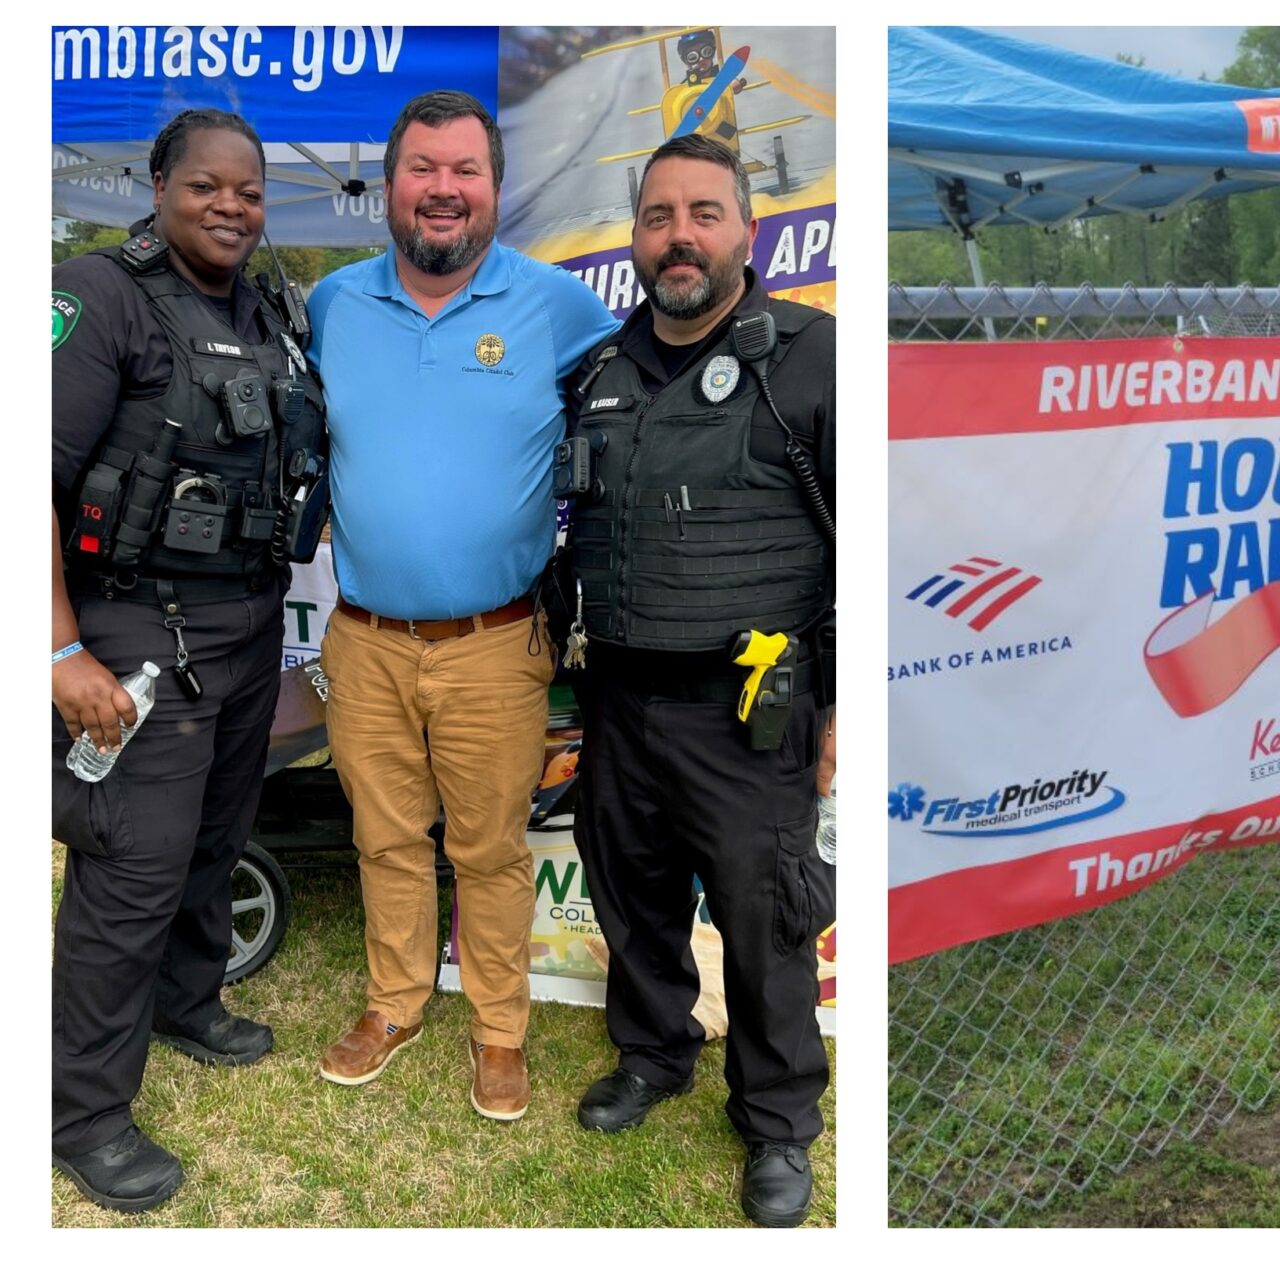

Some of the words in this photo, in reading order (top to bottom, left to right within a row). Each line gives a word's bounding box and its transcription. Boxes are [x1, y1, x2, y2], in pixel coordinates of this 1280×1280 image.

[82, 503, 103, 521] TQ
[888, 657, 942, 681] BANK
[948, 650, 974, 669] OF
[980, 635, 1072, 664] AMERICA
[965, 809, 1021, 830] medical
[1024, 794, 1082, 819] transport
[1068, 829, 1223, 898] Thanks
[549, 906, 599, 923] COL
